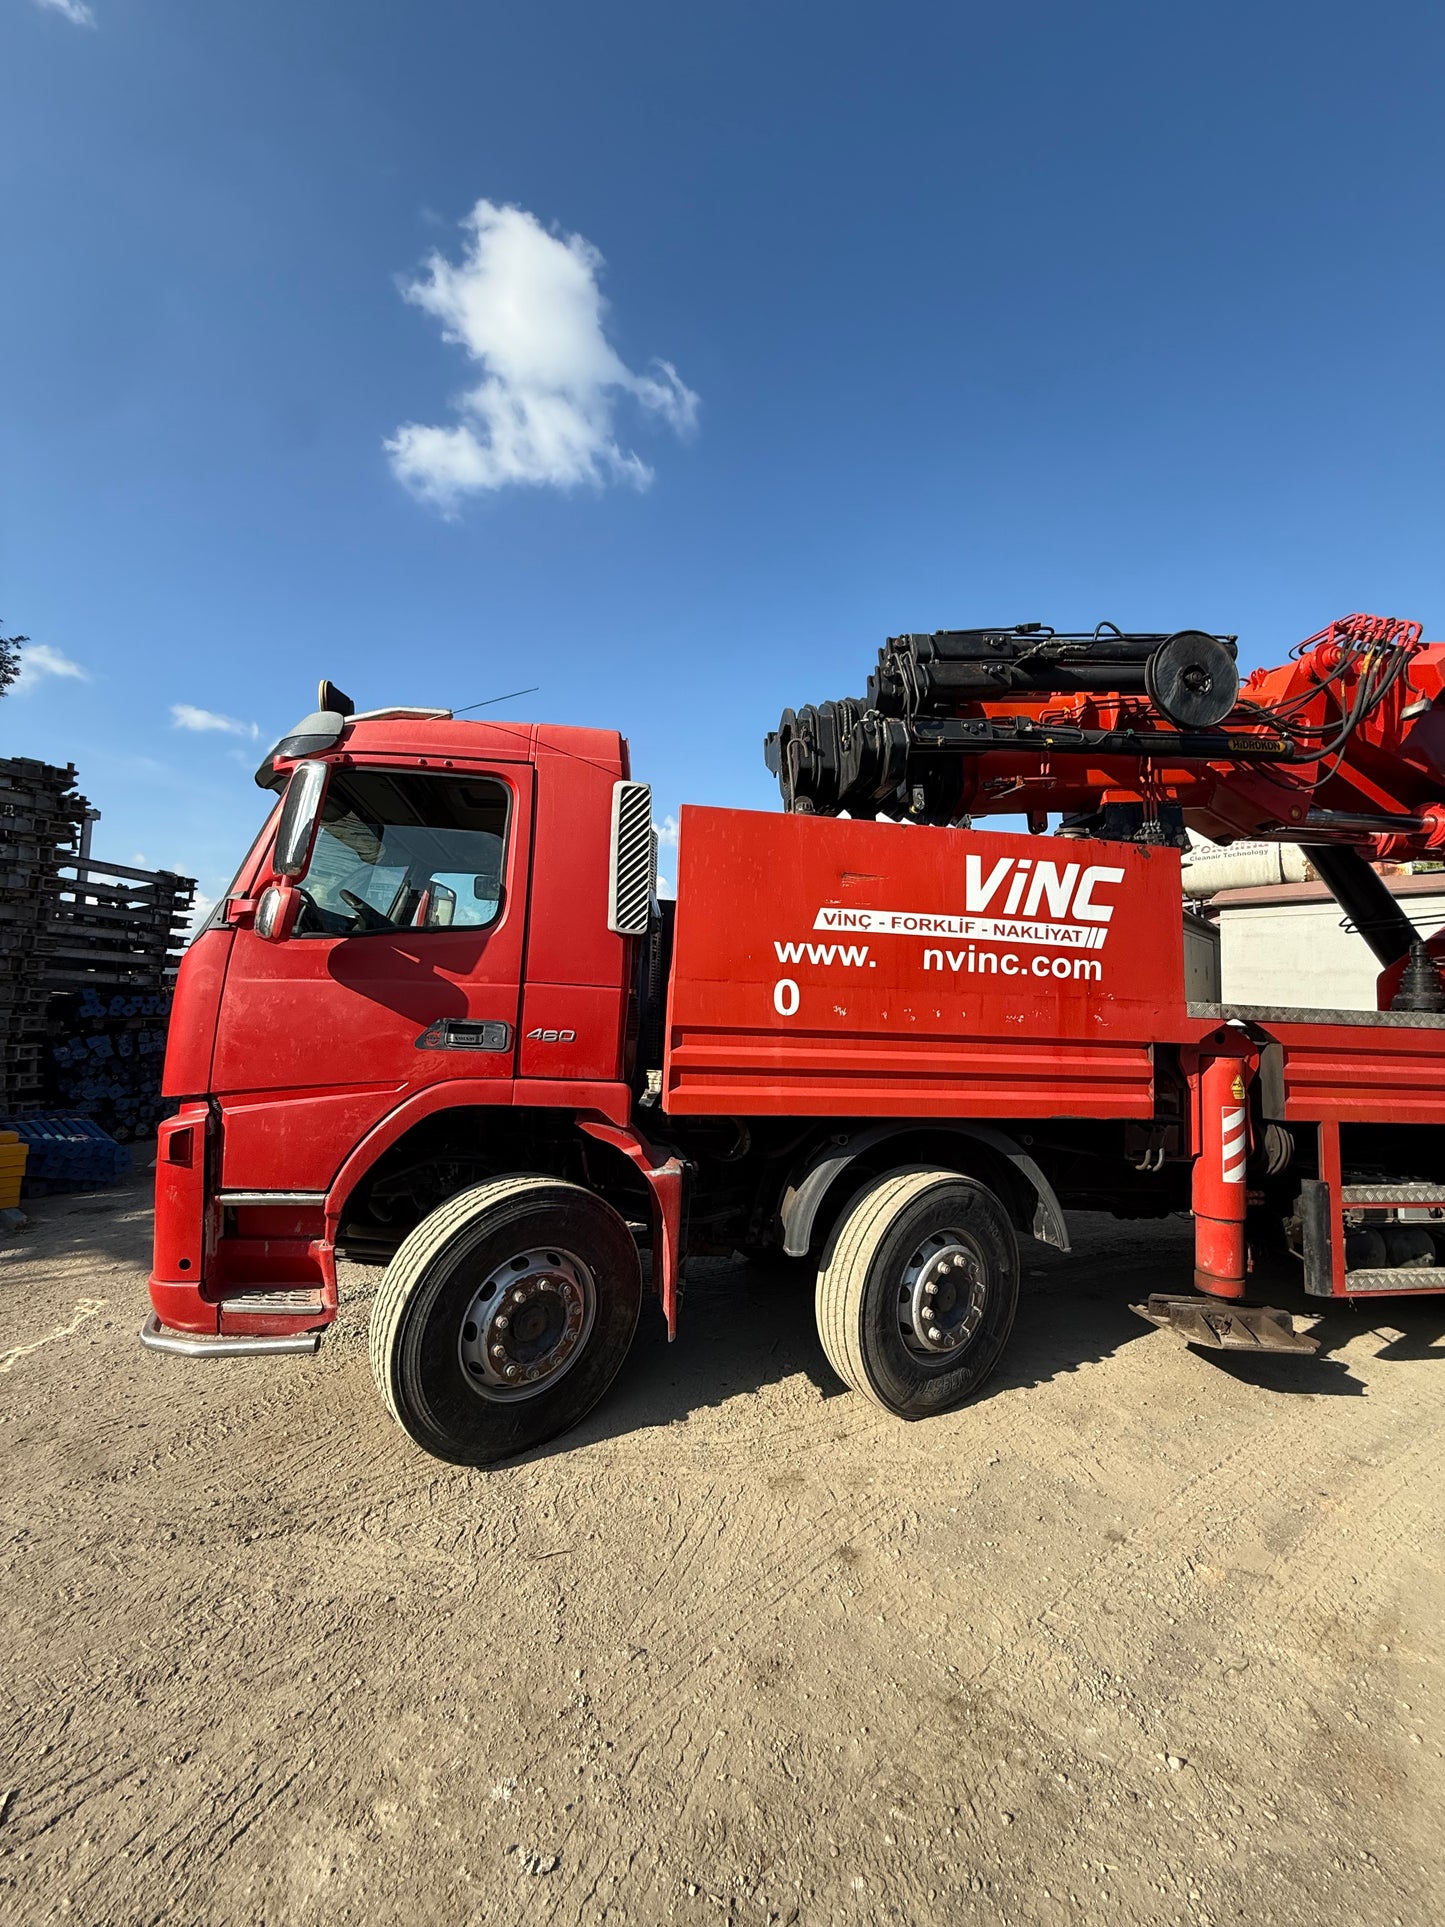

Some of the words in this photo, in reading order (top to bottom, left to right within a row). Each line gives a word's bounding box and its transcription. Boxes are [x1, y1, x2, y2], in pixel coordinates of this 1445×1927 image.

[1189, 853, 1221, 861] Cleanair
[1223, 849, 1269, 858] Technology
[823, 911, 872, 930] VİNÇ
[890, 916, 976, 935] FORKLİF
[993, 923, 1083, 943] NAKLİYAT
[774, 941, 877, 968] www.
[923, 944, 1102, 981] nvinc.com
[774, 979, 800, 1016] 0
[526, 1028, 575, 1042] 460
